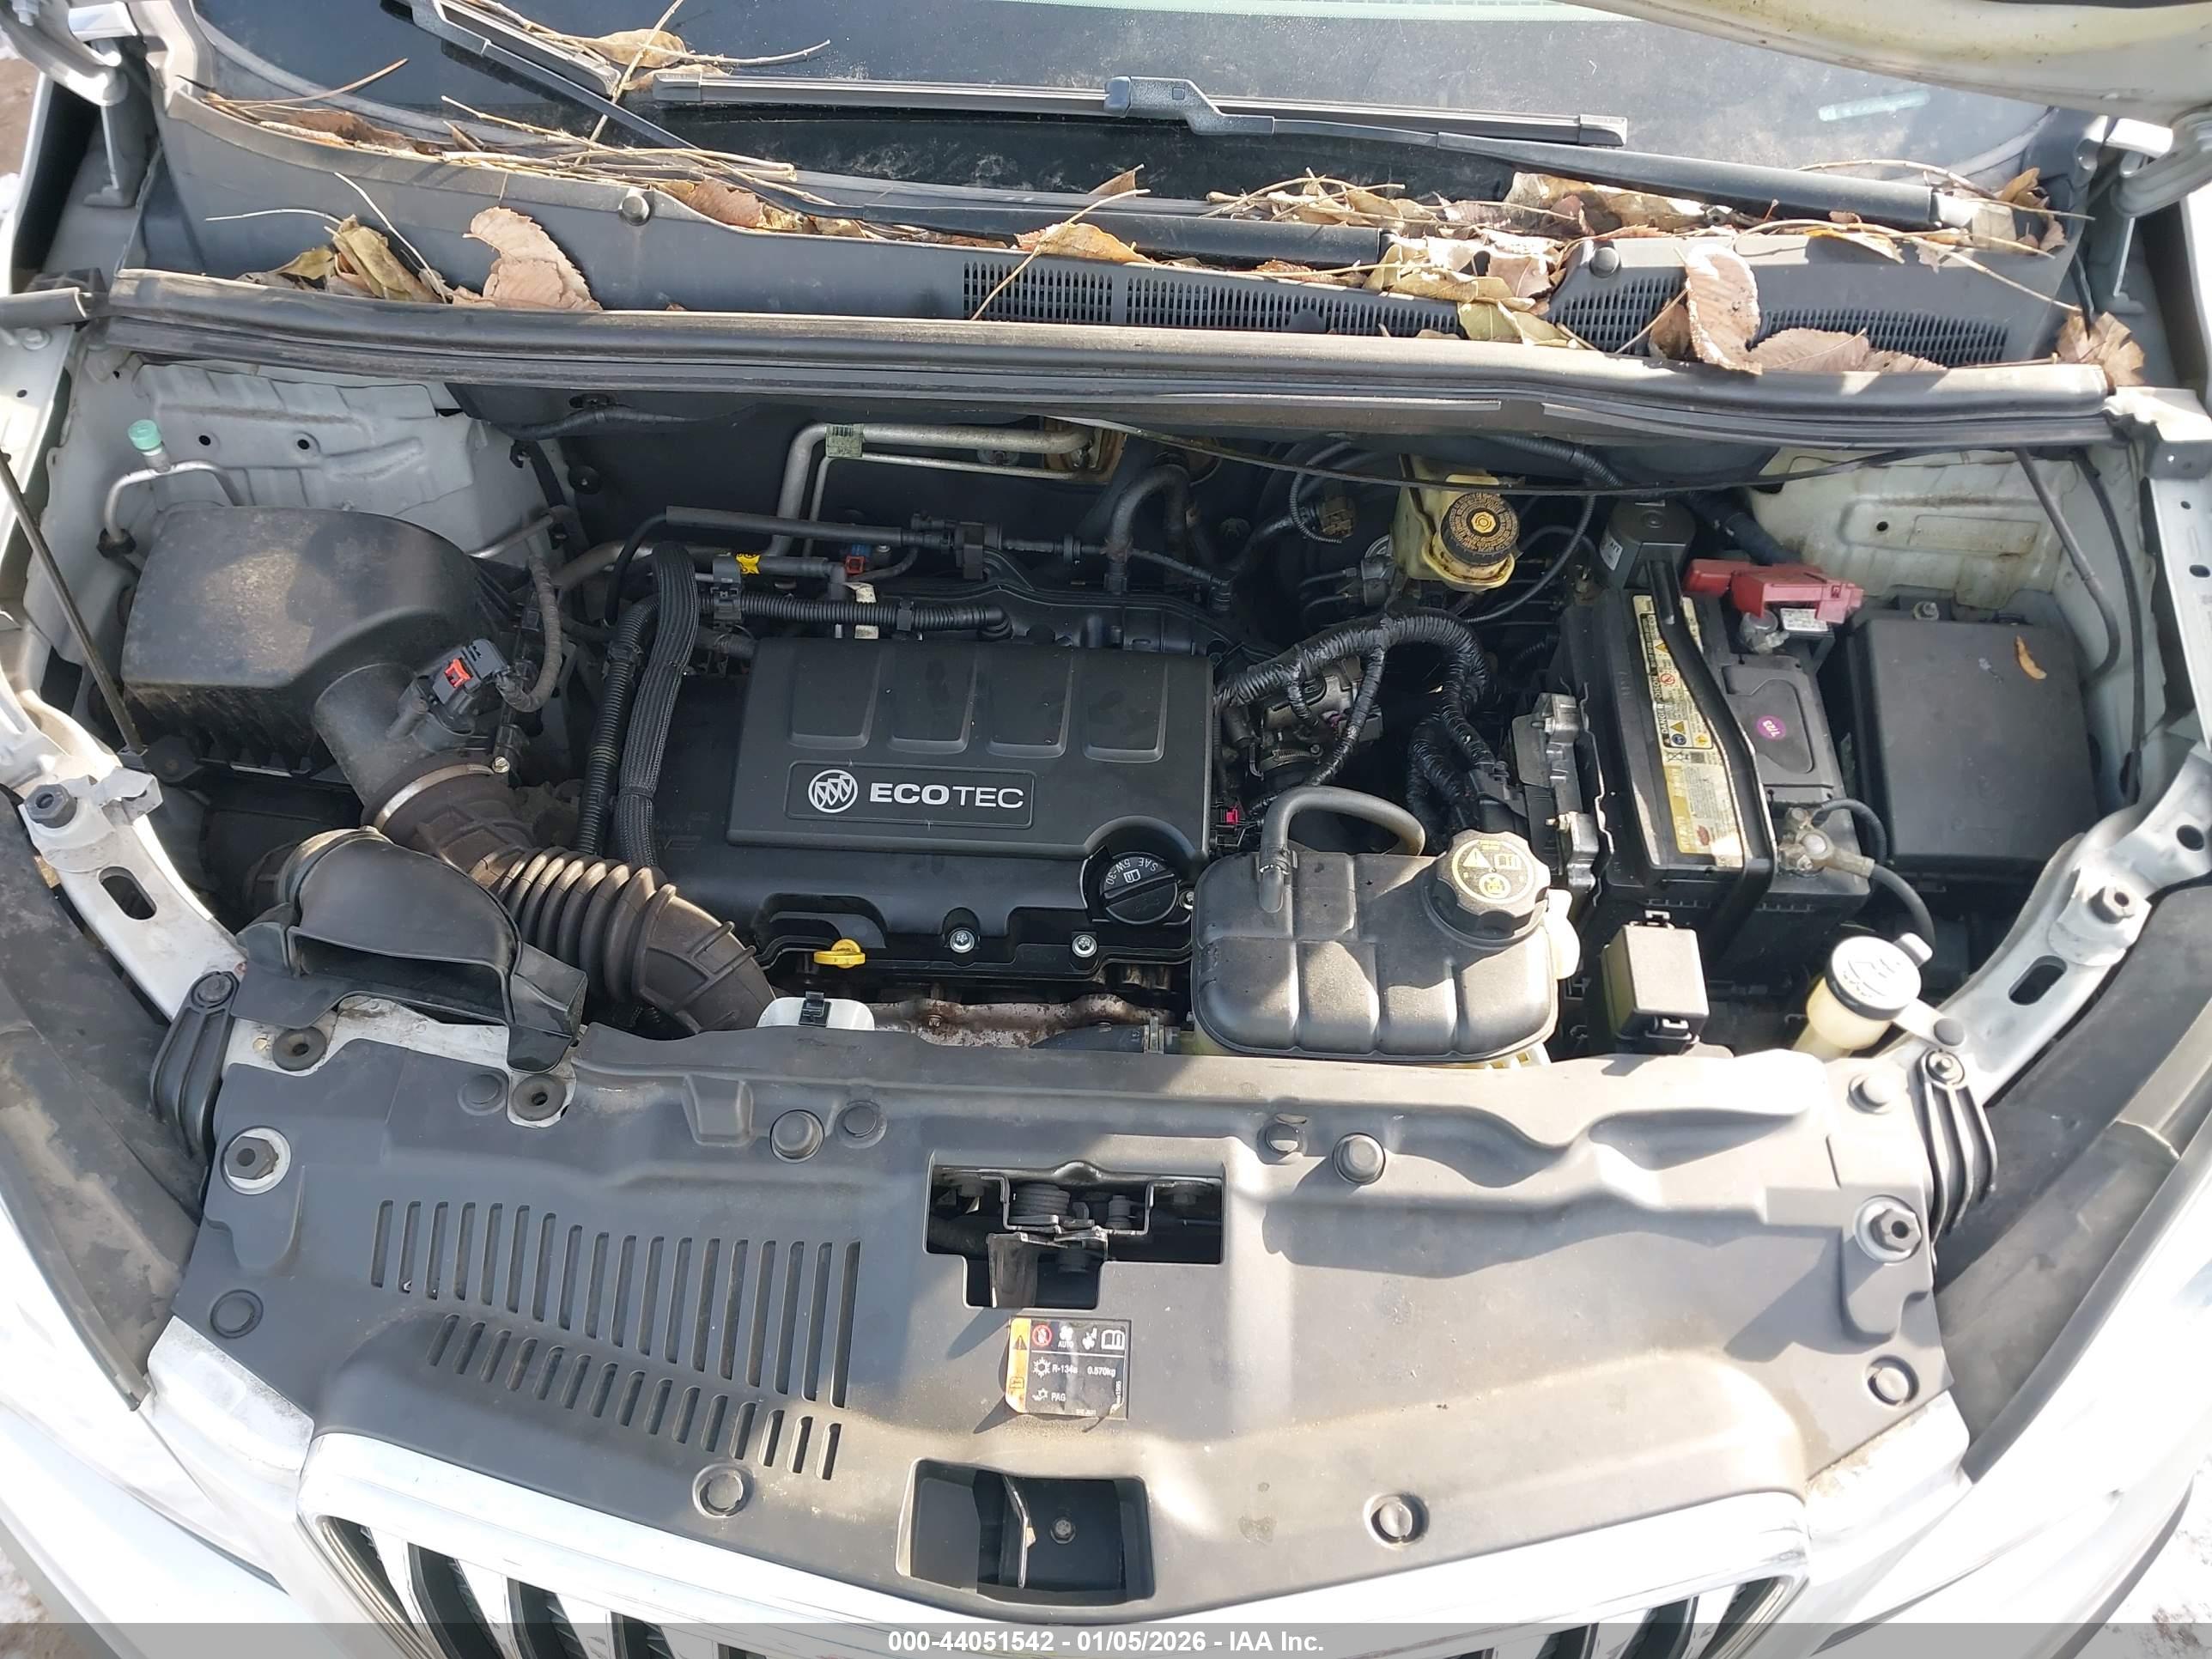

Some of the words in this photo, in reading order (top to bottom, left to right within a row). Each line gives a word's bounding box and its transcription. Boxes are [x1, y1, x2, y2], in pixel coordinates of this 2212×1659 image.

[1657, 703, 1668, 734] DANGER
[870, 782, 1024, 809] ECOTEC
[1105, 858, 1131, 885] 5W-30
[1137, 857, 1158, 872] SAE
[1058, 1340, 1074, 1349] AUTO
[1052, 1364, 1079, 1374] R-134a
[1051, 1392, 1066, 1401] PAG
